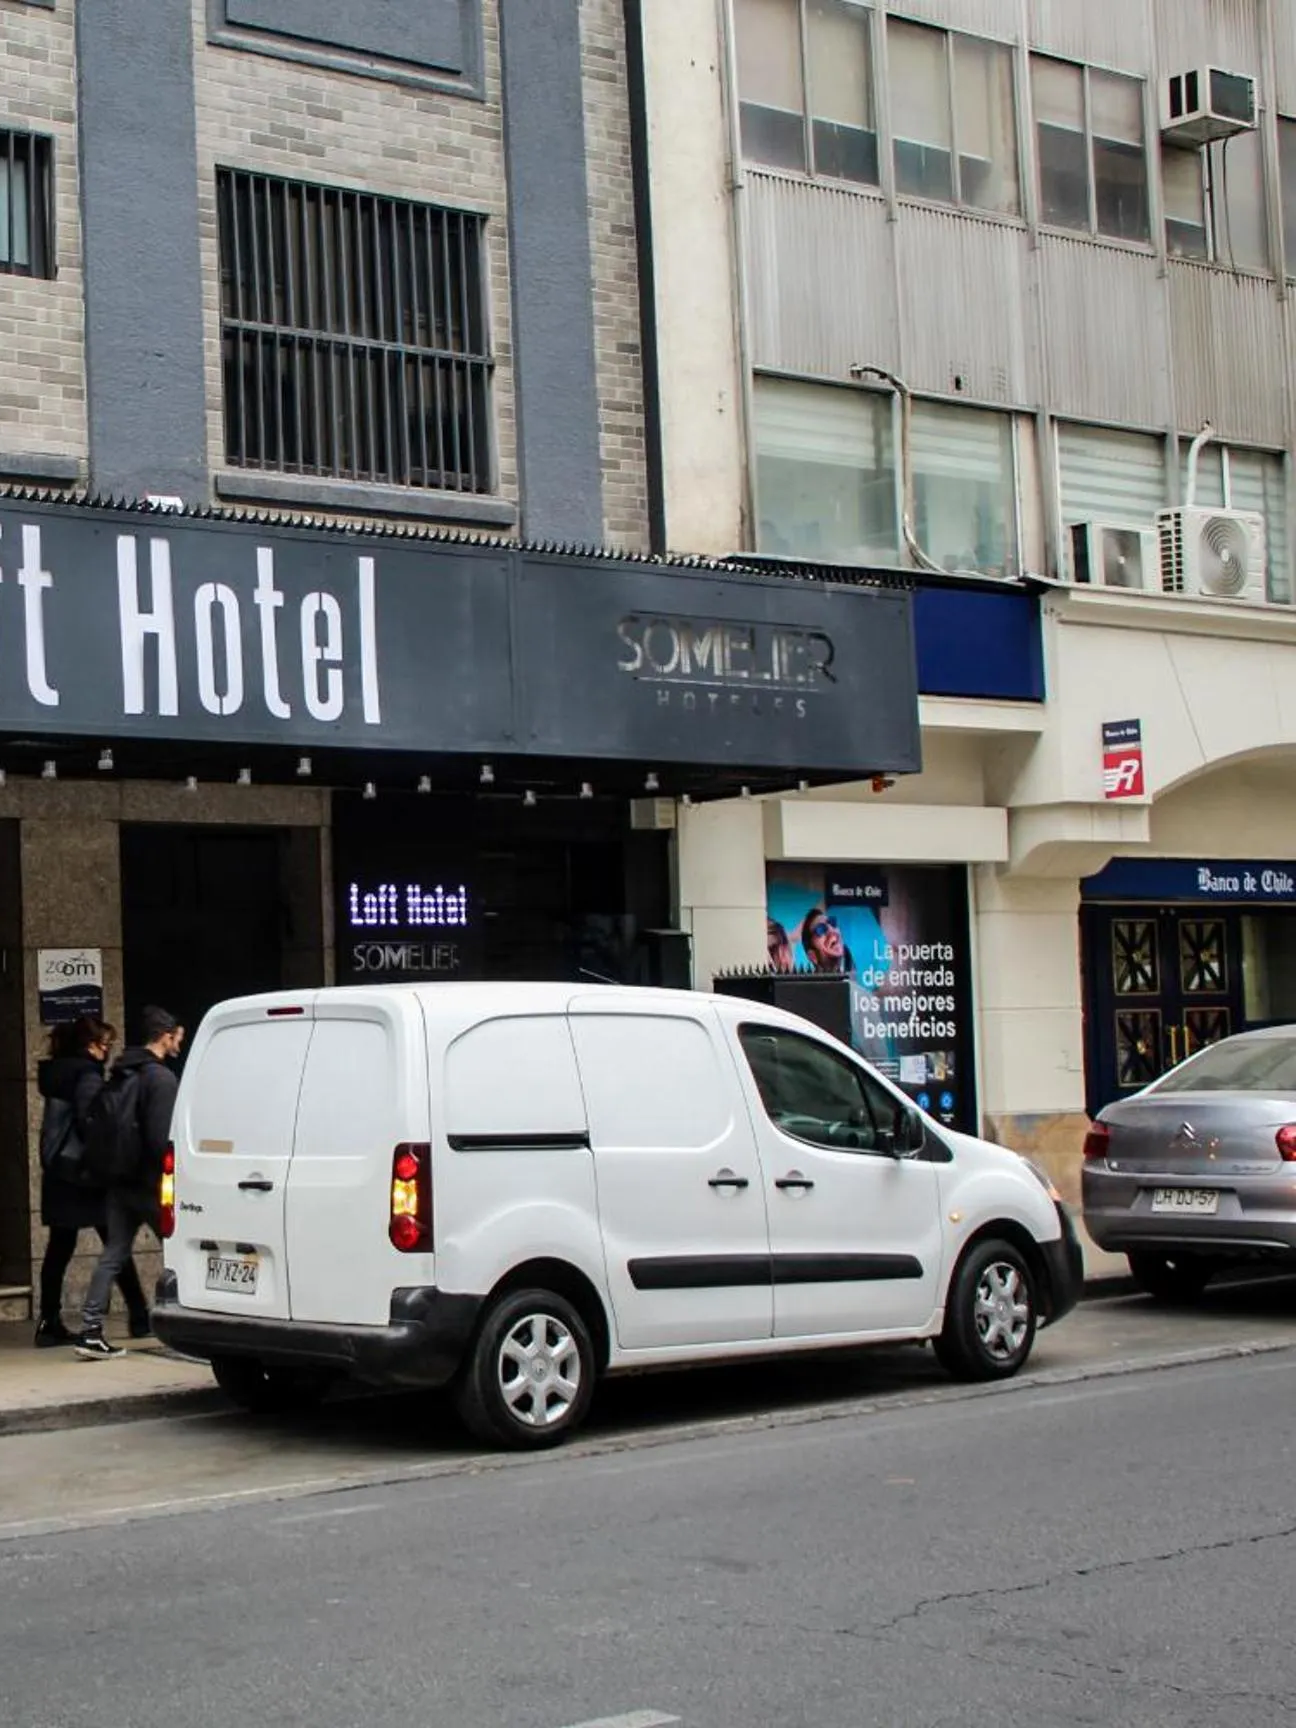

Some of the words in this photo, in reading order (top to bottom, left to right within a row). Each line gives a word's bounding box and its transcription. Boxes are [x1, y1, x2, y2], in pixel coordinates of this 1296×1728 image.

[116, 534, 381, 725] Hotel
[1197, 866, 1240, 892] Banco
[1244, 871, 1257, 892] de
[1260, 869, 1295, 894] Chile
[350, 883, 398, 925] Loft
[407, 884, 467, 926] Hotel
[873, 939, 893, 960] La
[898, 941, 954, 965] puerta
[862, 963, 884, 986] de
[889, 964, 955, 987] entrada
[854, 991, 880, 1012] los
[884, 989, 955, 1018] mejores
[863, 1016, 956, 1038] beneficios
